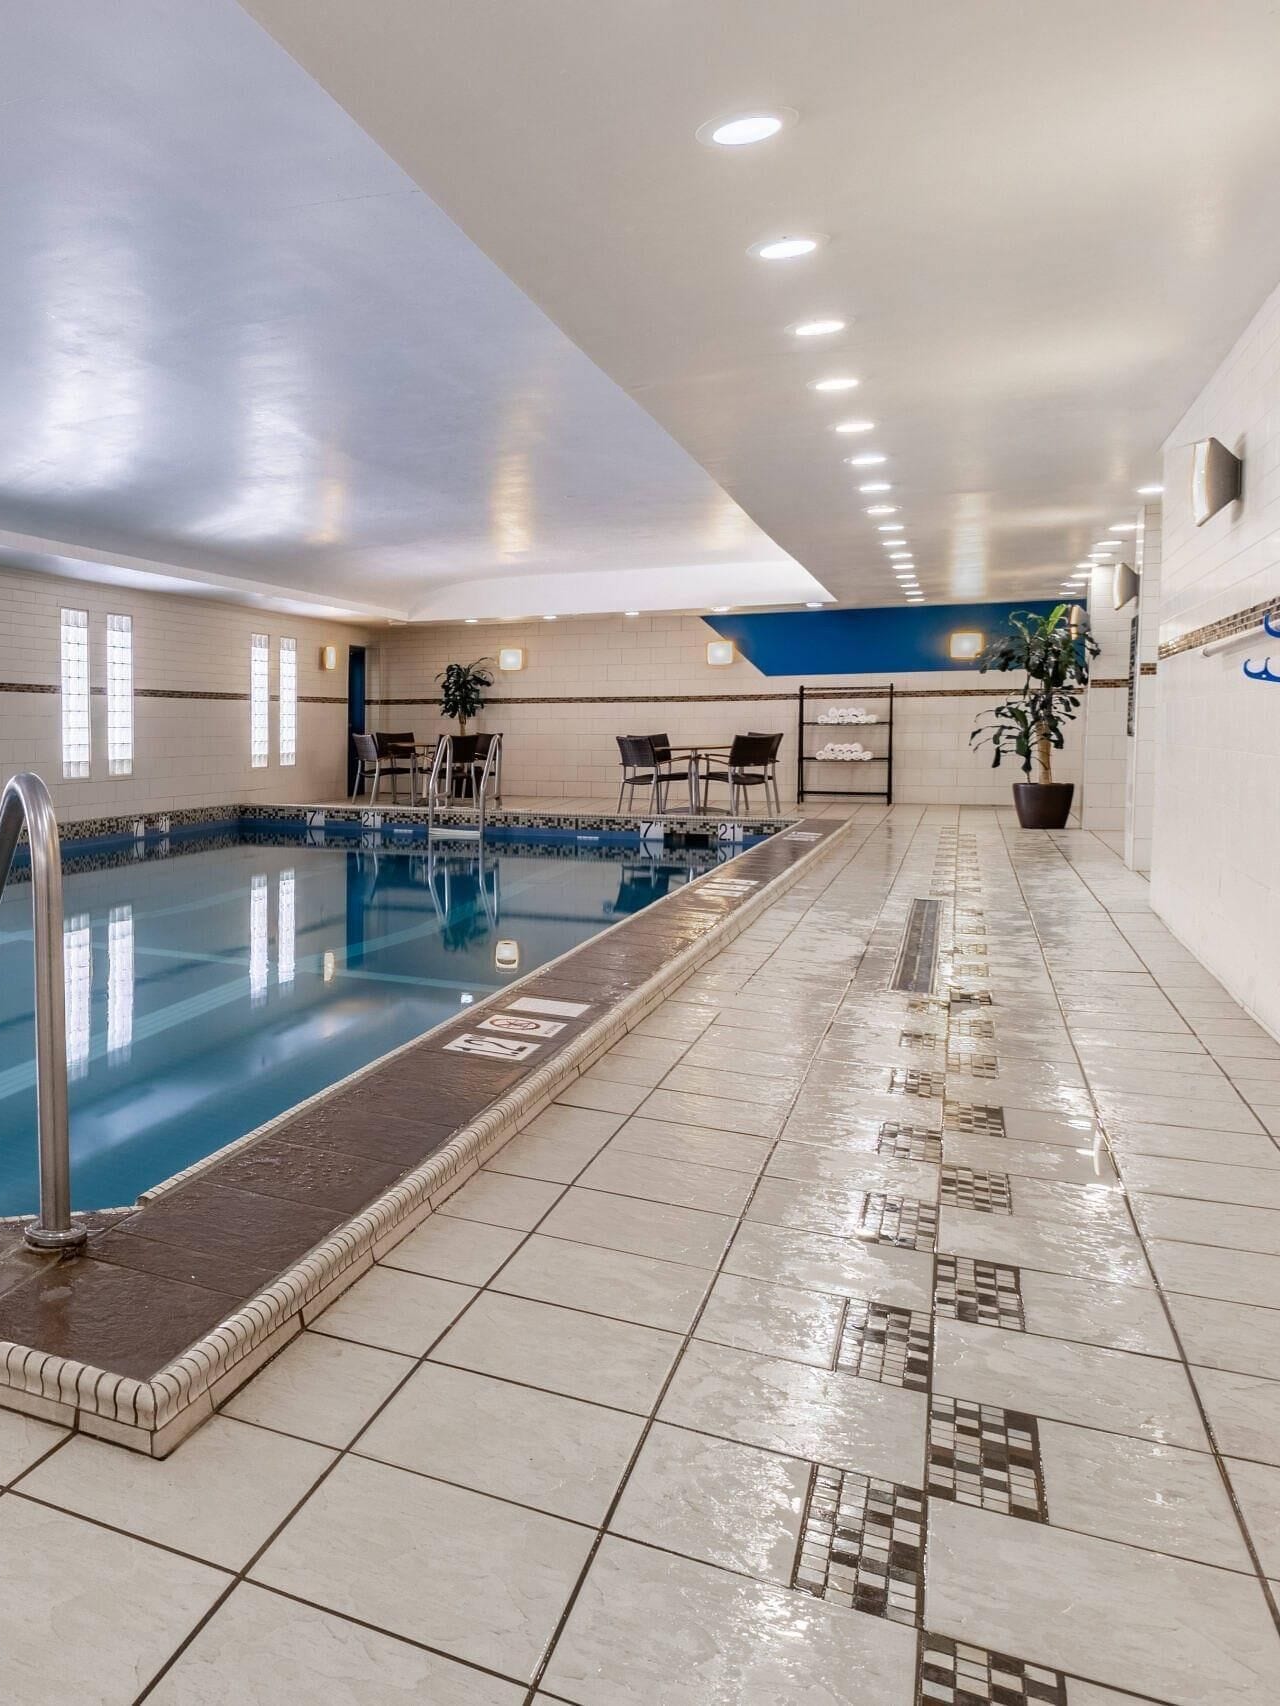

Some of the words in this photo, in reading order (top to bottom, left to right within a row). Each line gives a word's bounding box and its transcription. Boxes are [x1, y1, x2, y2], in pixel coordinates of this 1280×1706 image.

[308, 811, 317, 826] 7
[642, 821, 654, 838] 7
[719, 823, 735, 841] 2.1
